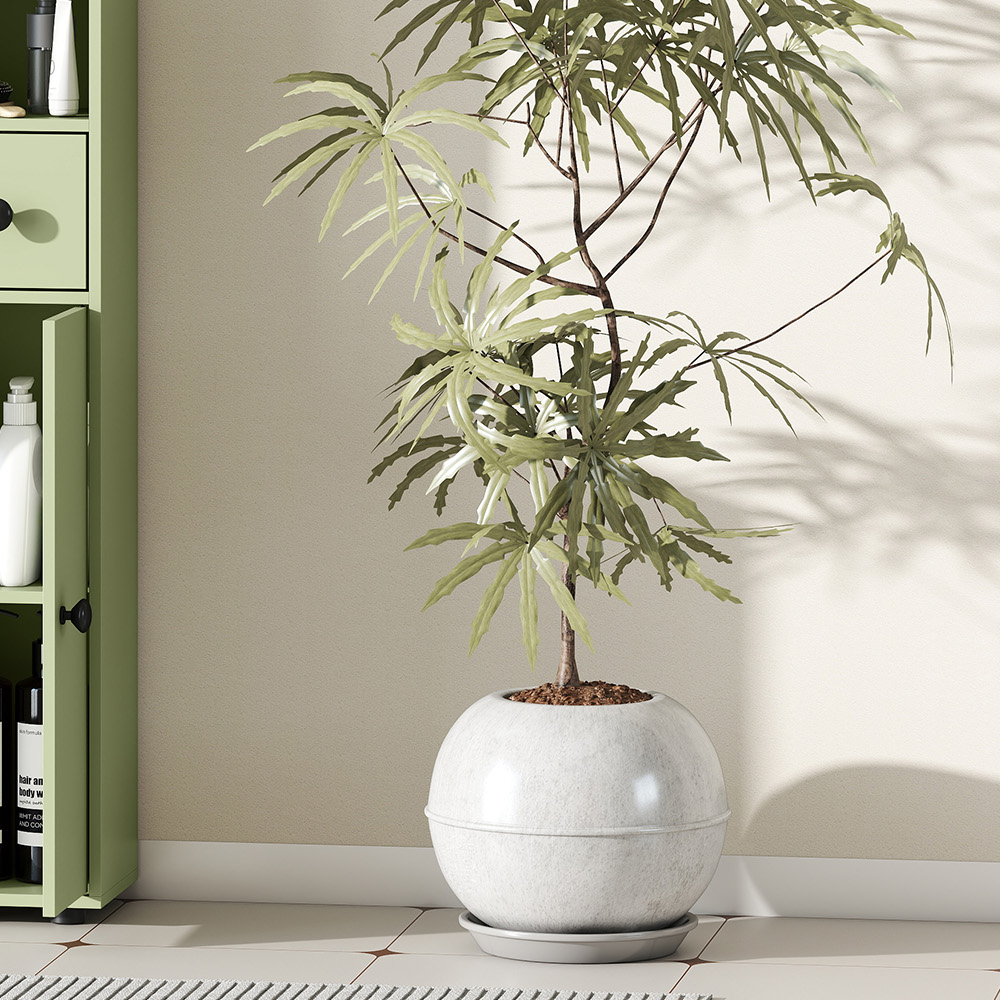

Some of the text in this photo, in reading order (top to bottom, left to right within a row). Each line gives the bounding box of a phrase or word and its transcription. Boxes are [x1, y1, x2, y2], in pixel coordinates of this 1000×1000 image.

[19, 774, 31, 785] hair
[19, 786, 35, 799] body
[19, 820, 30, 828] AND
